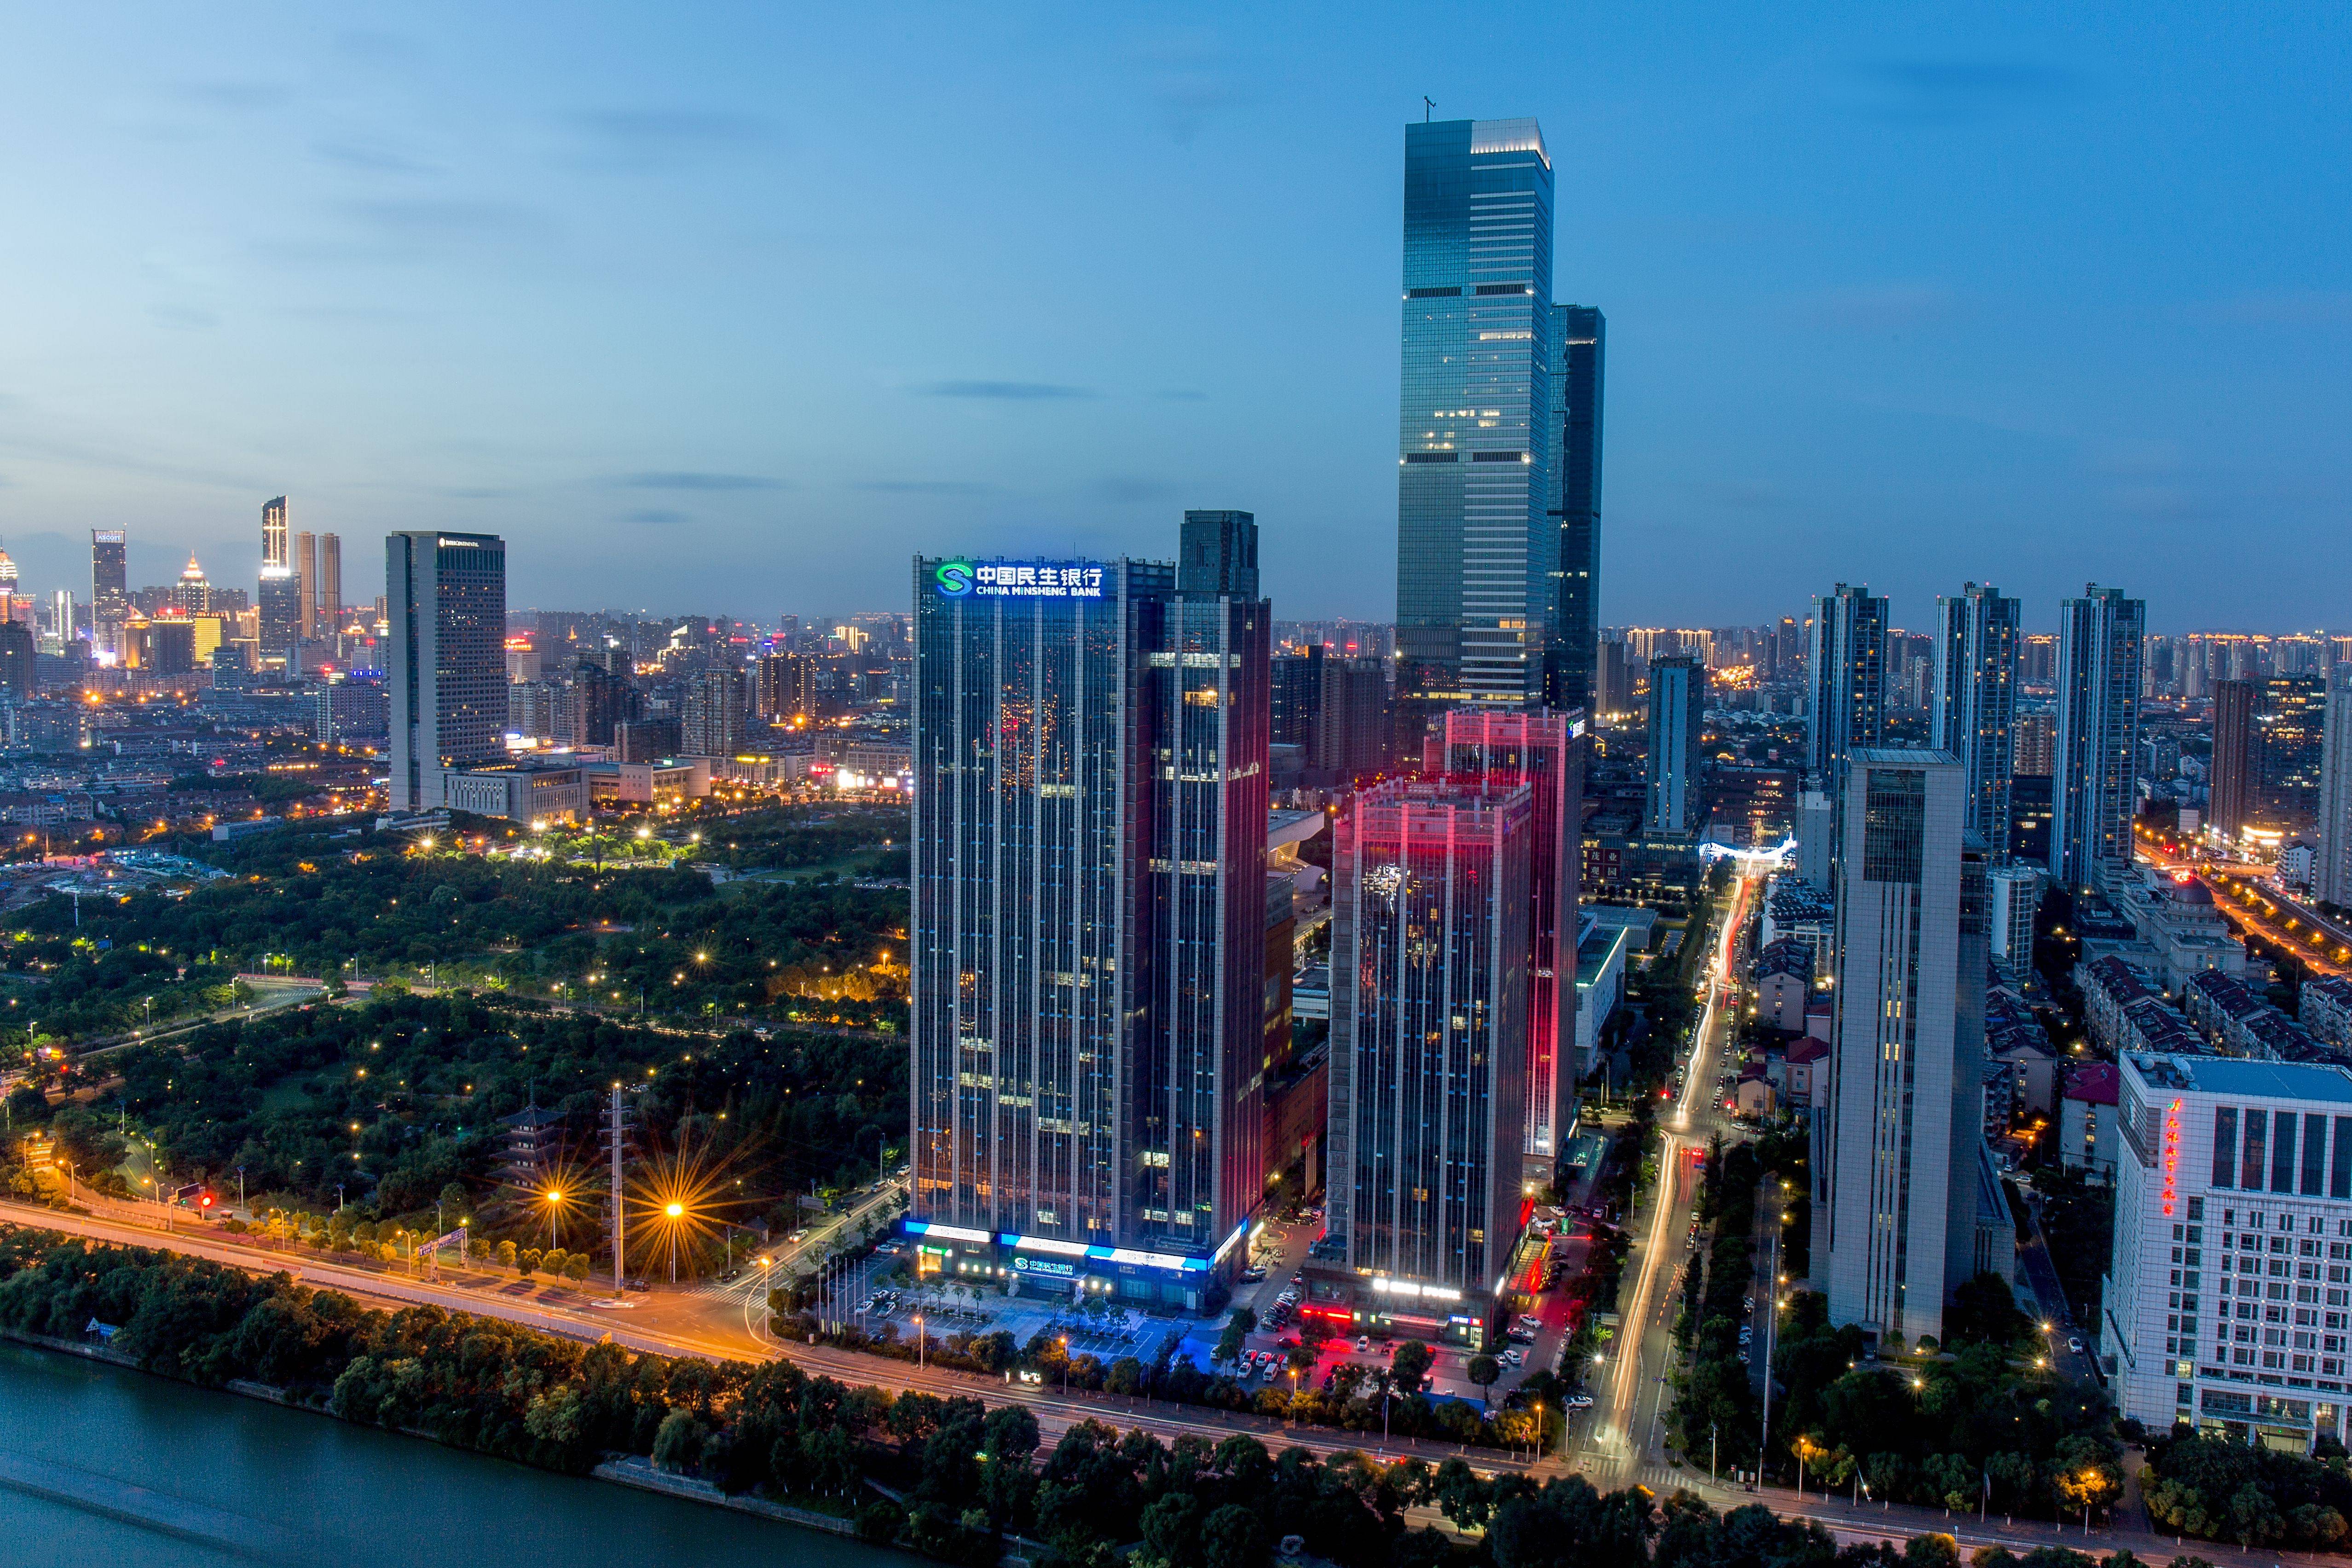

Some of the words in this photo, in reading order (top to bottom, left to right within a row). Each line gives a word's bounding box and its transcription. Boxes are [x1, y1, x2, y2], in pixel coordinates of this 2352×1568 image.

[977, 566, 1103, 587] 中国民生银行
[976, 586, 1010, 595] CHINA
[1012, 586, 1067, 596] MINSHENG
[1070, 587, 1101, 596] BANK
